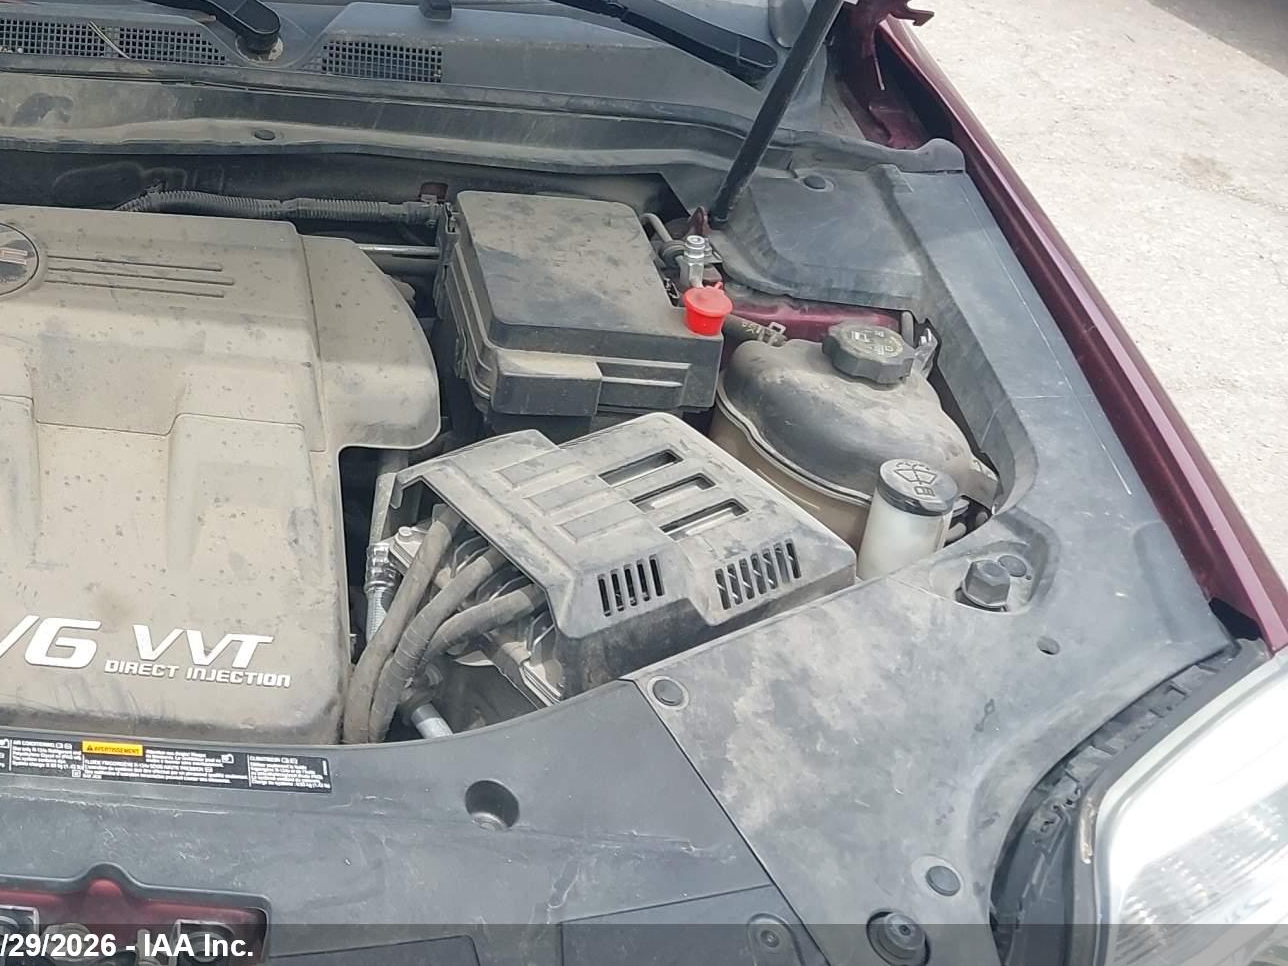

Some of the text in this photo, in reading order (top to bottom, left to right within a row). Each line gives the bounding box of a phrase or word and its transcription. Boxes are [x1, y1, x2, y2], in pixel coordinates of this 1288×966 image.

[132, 625, 274, 668] VVT
[104, 659, 291, 688] DIRECT INJECTION
